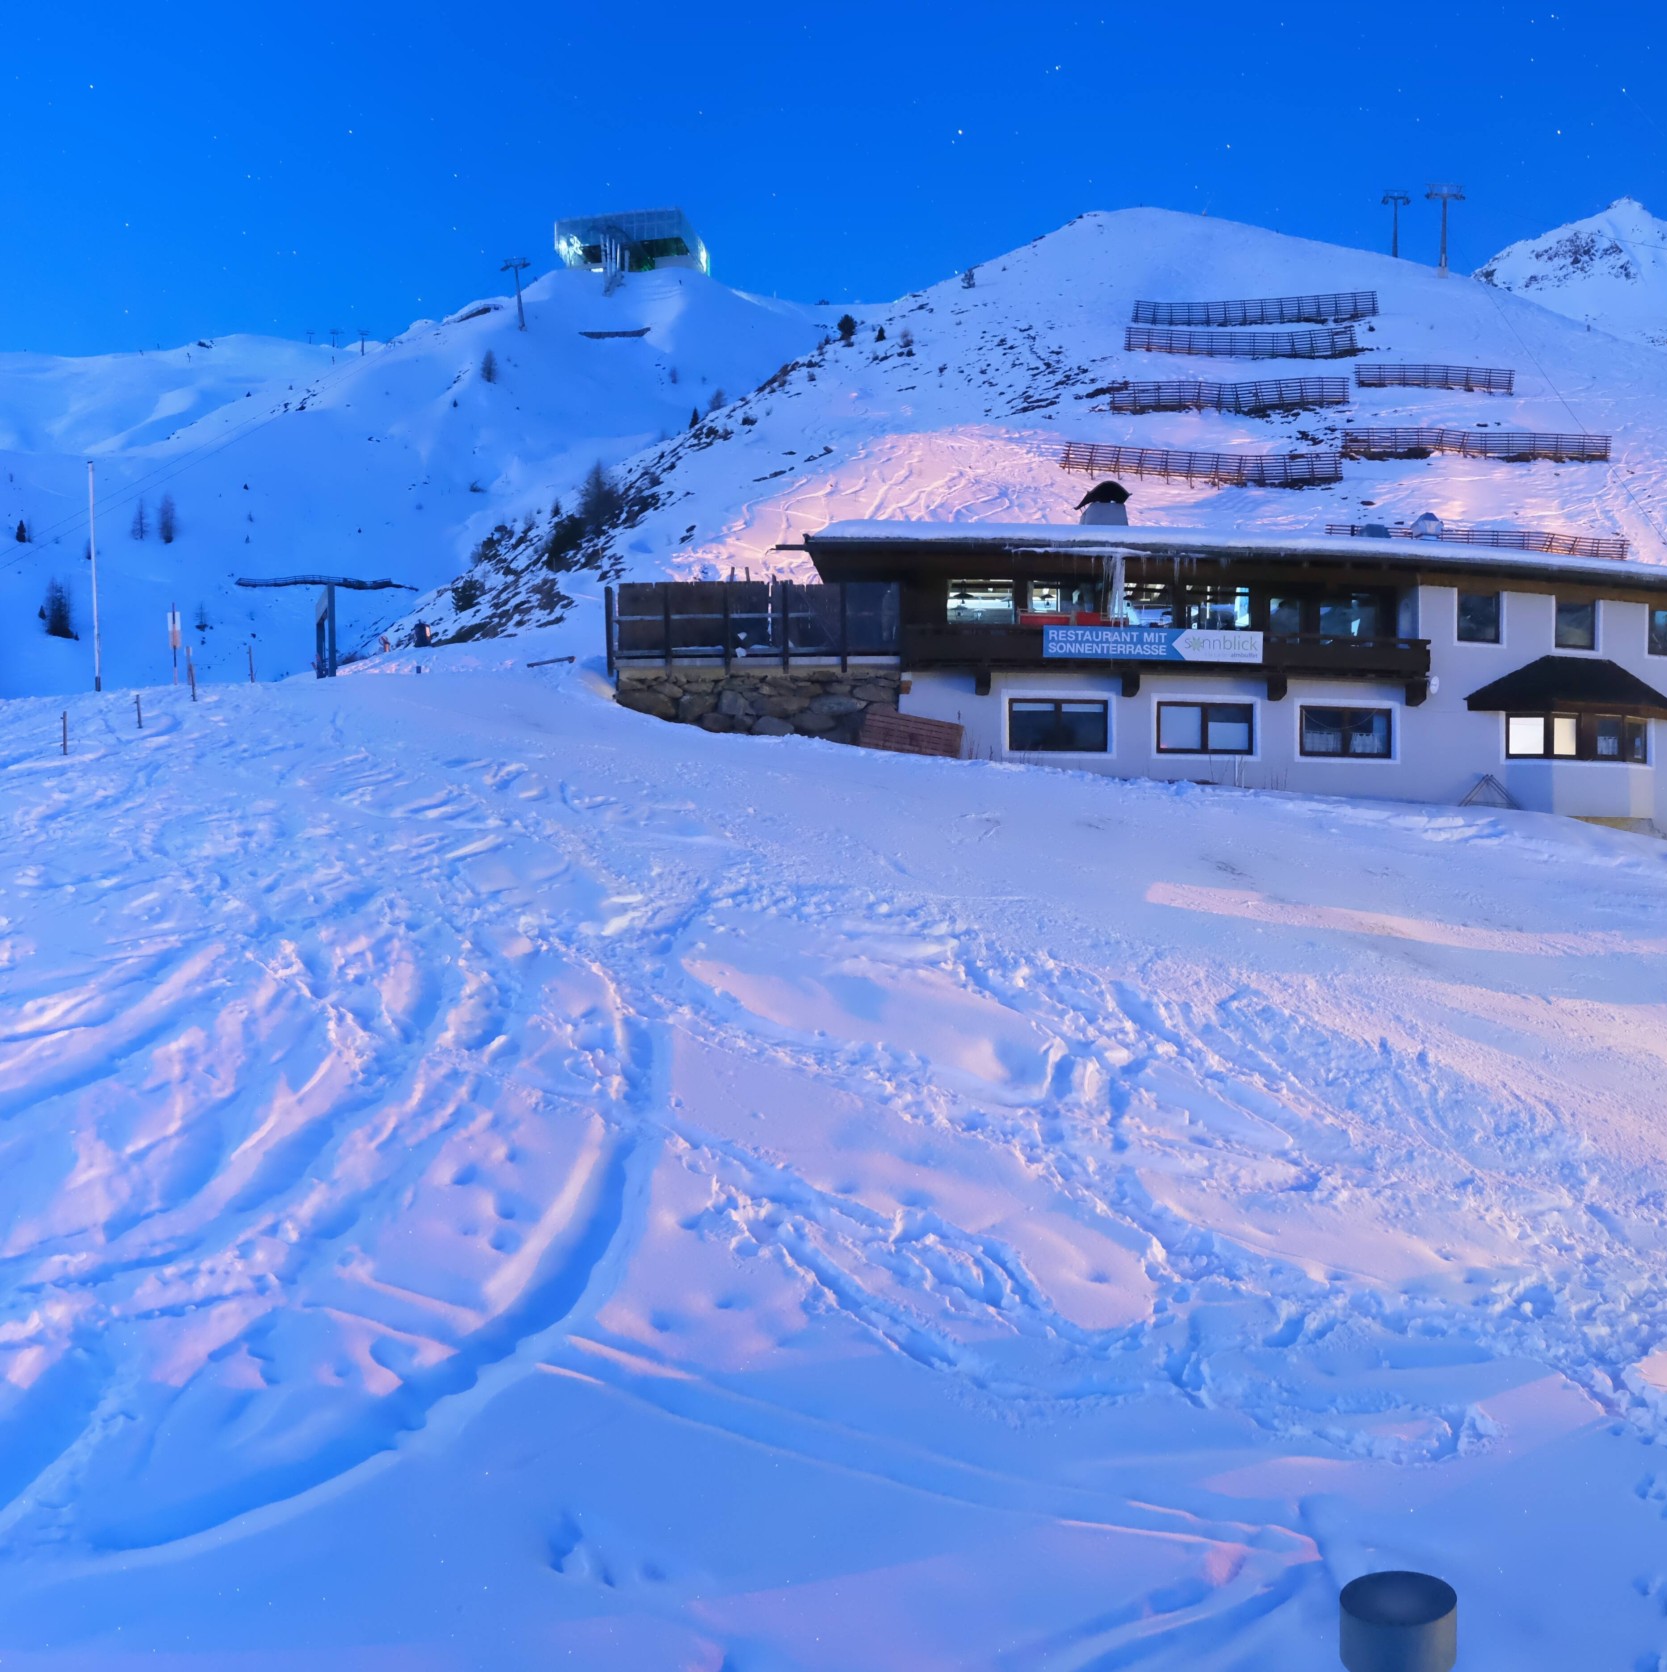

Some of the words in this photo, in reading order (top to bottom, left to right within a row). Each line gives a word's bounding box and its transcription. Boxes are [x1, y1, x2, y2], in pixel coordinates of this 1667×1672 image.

[1049, 629, 1139, 643] RESTAURANT
[1143, 632, 1167, 643] MIT
[1048, 642, 1167, 656] SONNENTERRASSE
